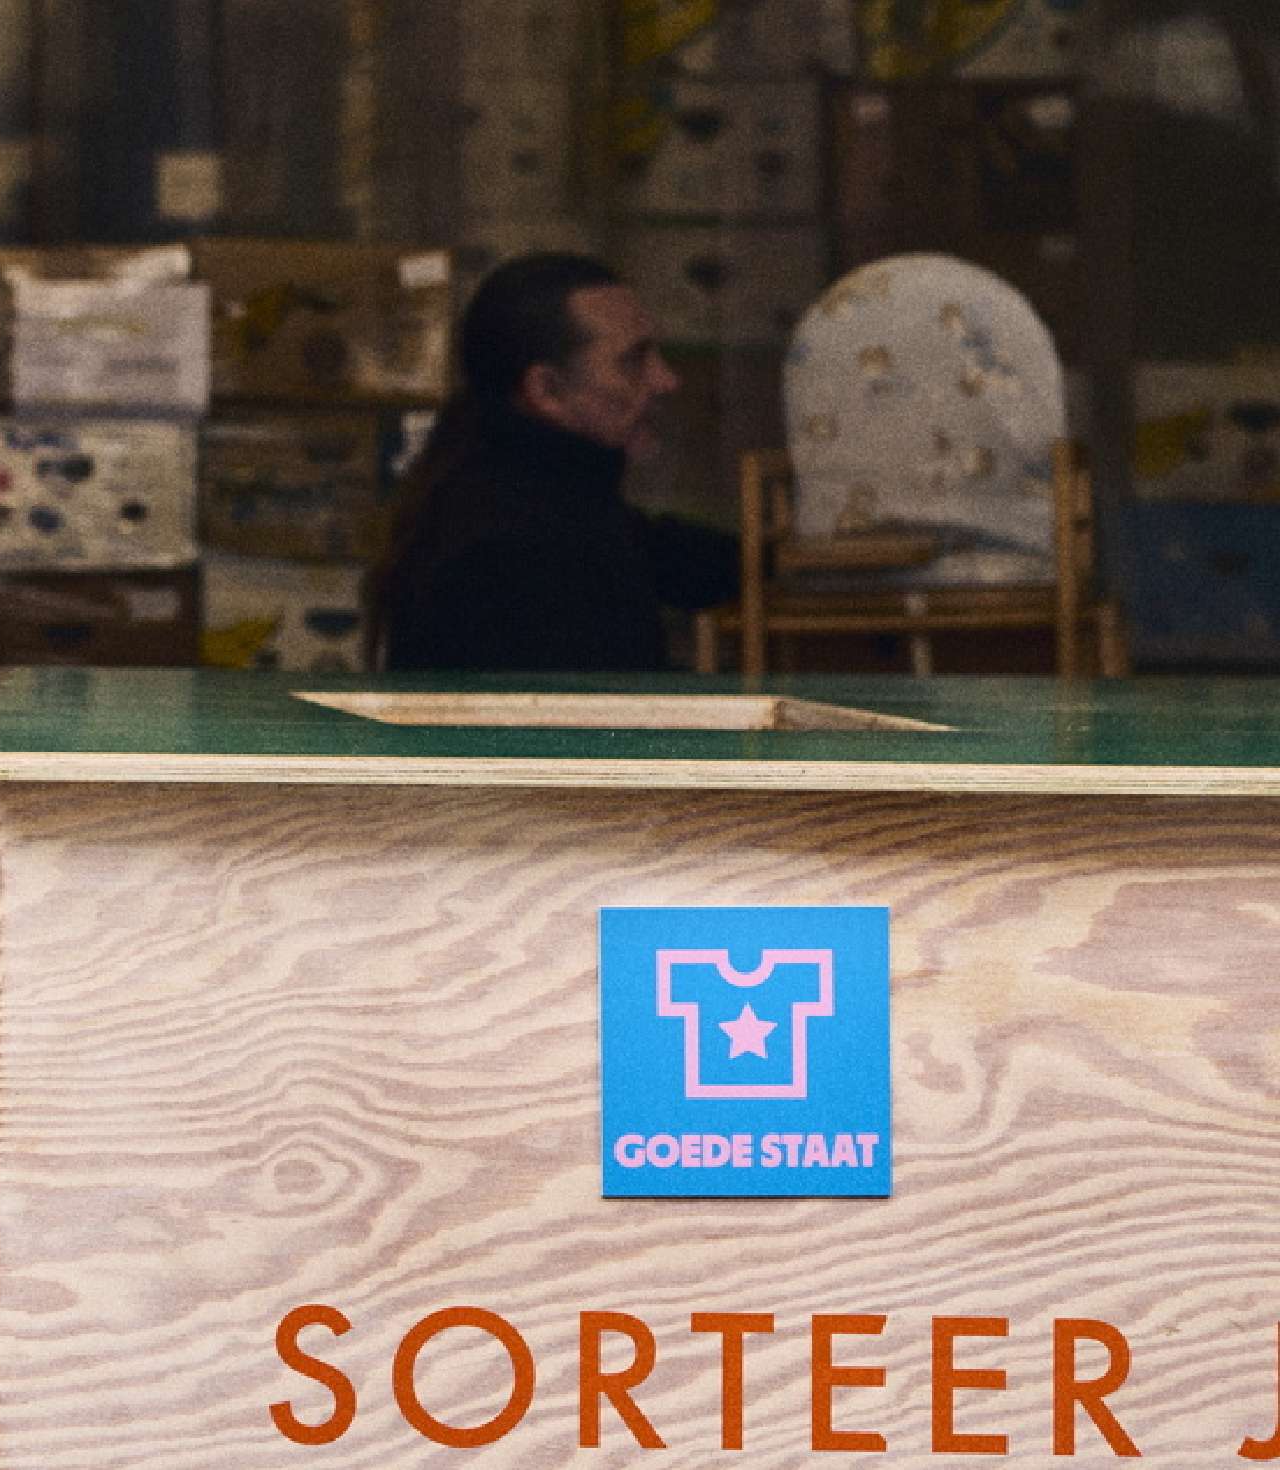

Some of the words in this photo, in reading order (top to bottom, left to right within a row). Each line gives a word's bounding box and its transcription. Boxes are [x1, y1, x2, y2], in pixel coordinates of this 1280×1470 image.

[613, 1133, 753, 1168] GOEDE
[760, 1133, 880, 1168] STAAT
[268, 1303, 1143, 1459] SORTEER
